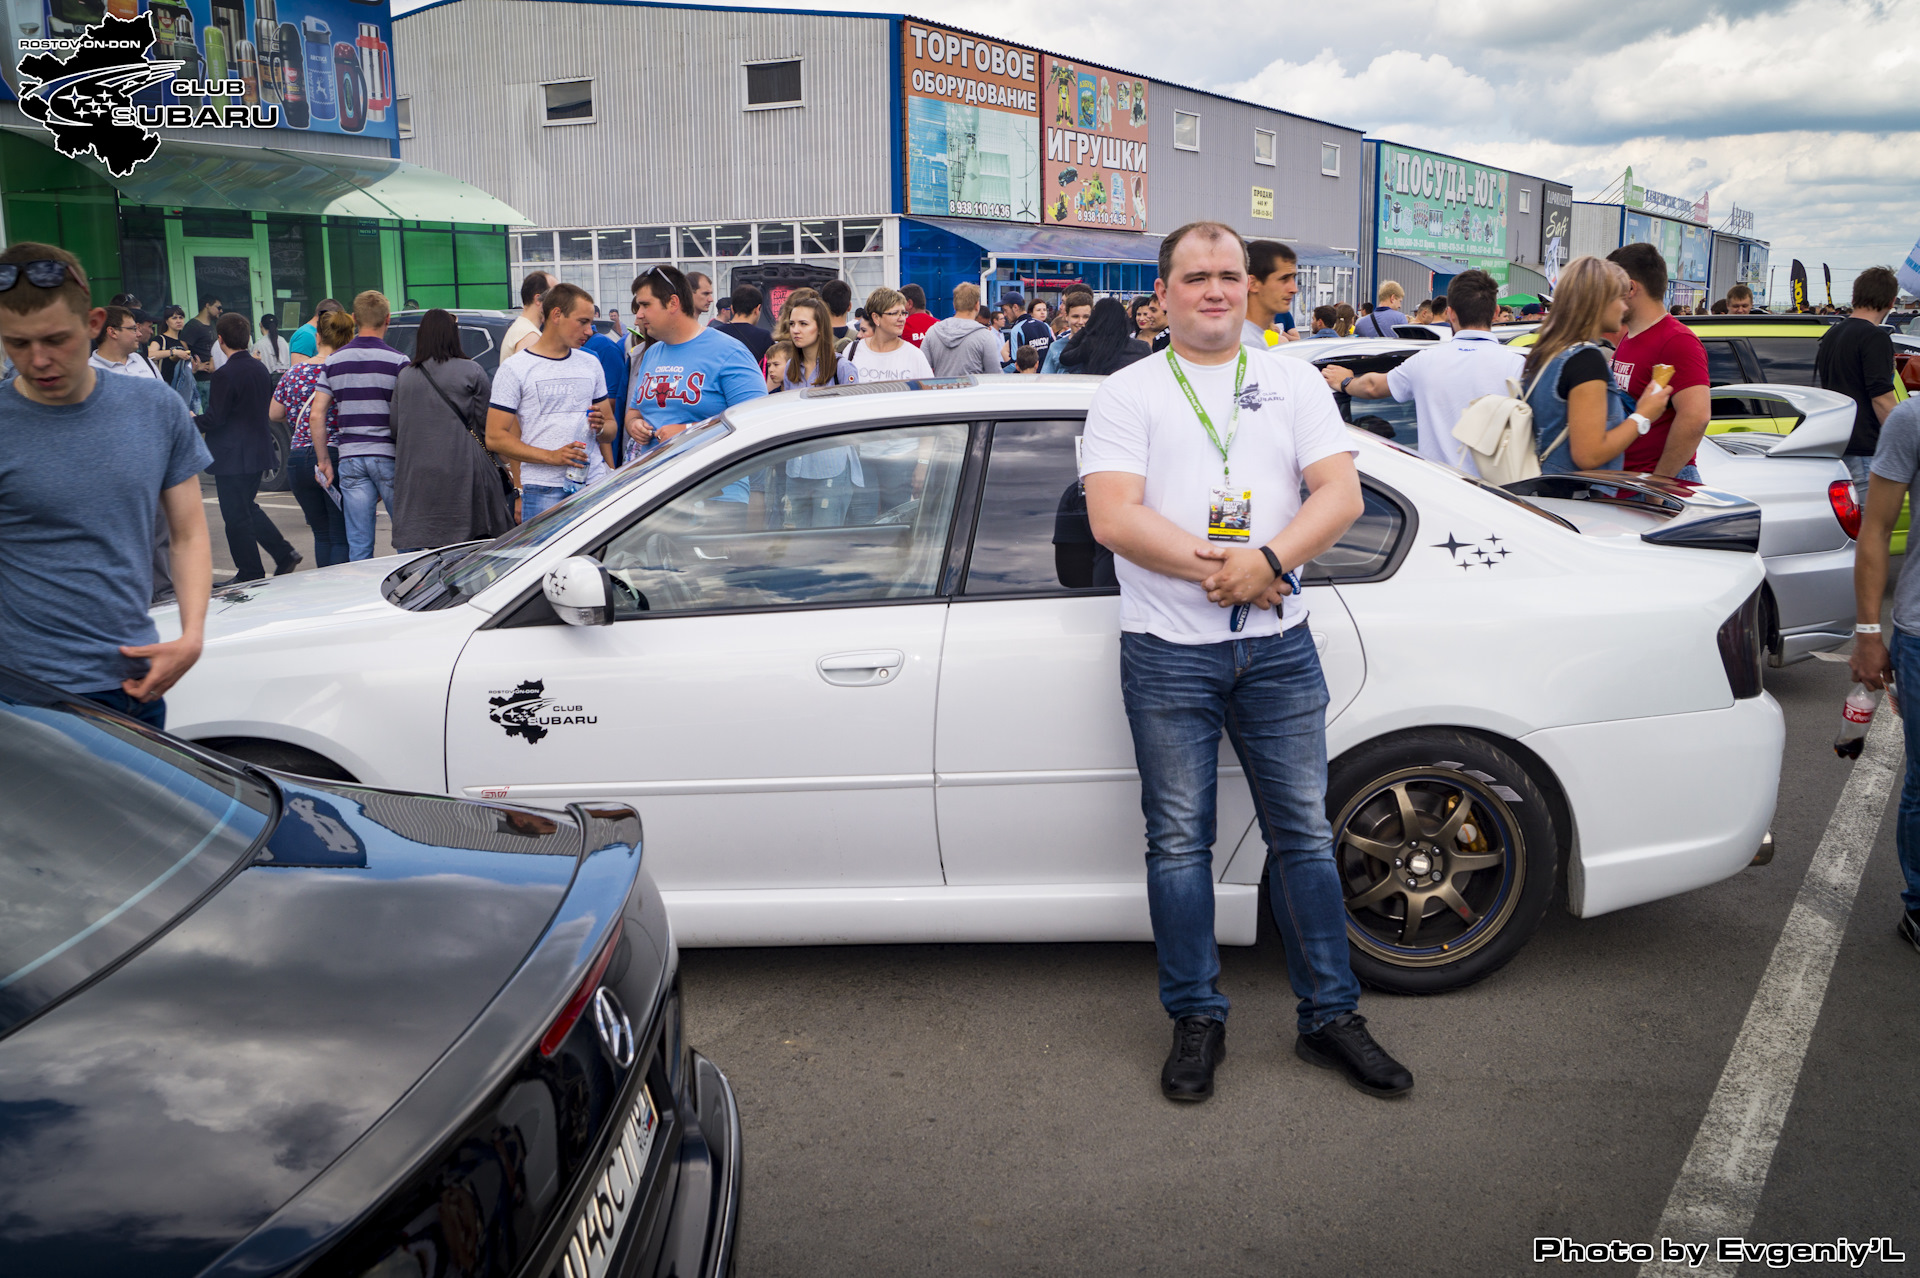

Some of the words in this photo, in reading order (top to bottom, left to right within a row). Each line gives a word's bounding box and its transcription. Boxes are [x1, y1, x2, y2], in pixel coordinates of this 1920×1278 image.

[909, 26, 1036, 82] ТОРГОВОЕ
[912, 68, 1037, 112] ОБОРУДОВАНИЕ
[1047, 126, 1147, 173] ИГРУШКИ
[1395, 152, 1497, 211] ПОСУДА-ЮГ
[949, 200, 955, 213] 8
[956, 201, 972, 215] 938
[973, 202, 988, 217] 110
[1077, 209, 1082, 222] 8
[1083, 210, 1096, 223] 938
[1096, 211, 1108, 224] 110
[912, 332, 926, 341] BA
[859, 367, 911, 380] OOMING
[543, 383, 575, 397] NIKE
[1181, 381, 1204, 415] ALPHARD
[527, 715, 598, 727] SUBARU
